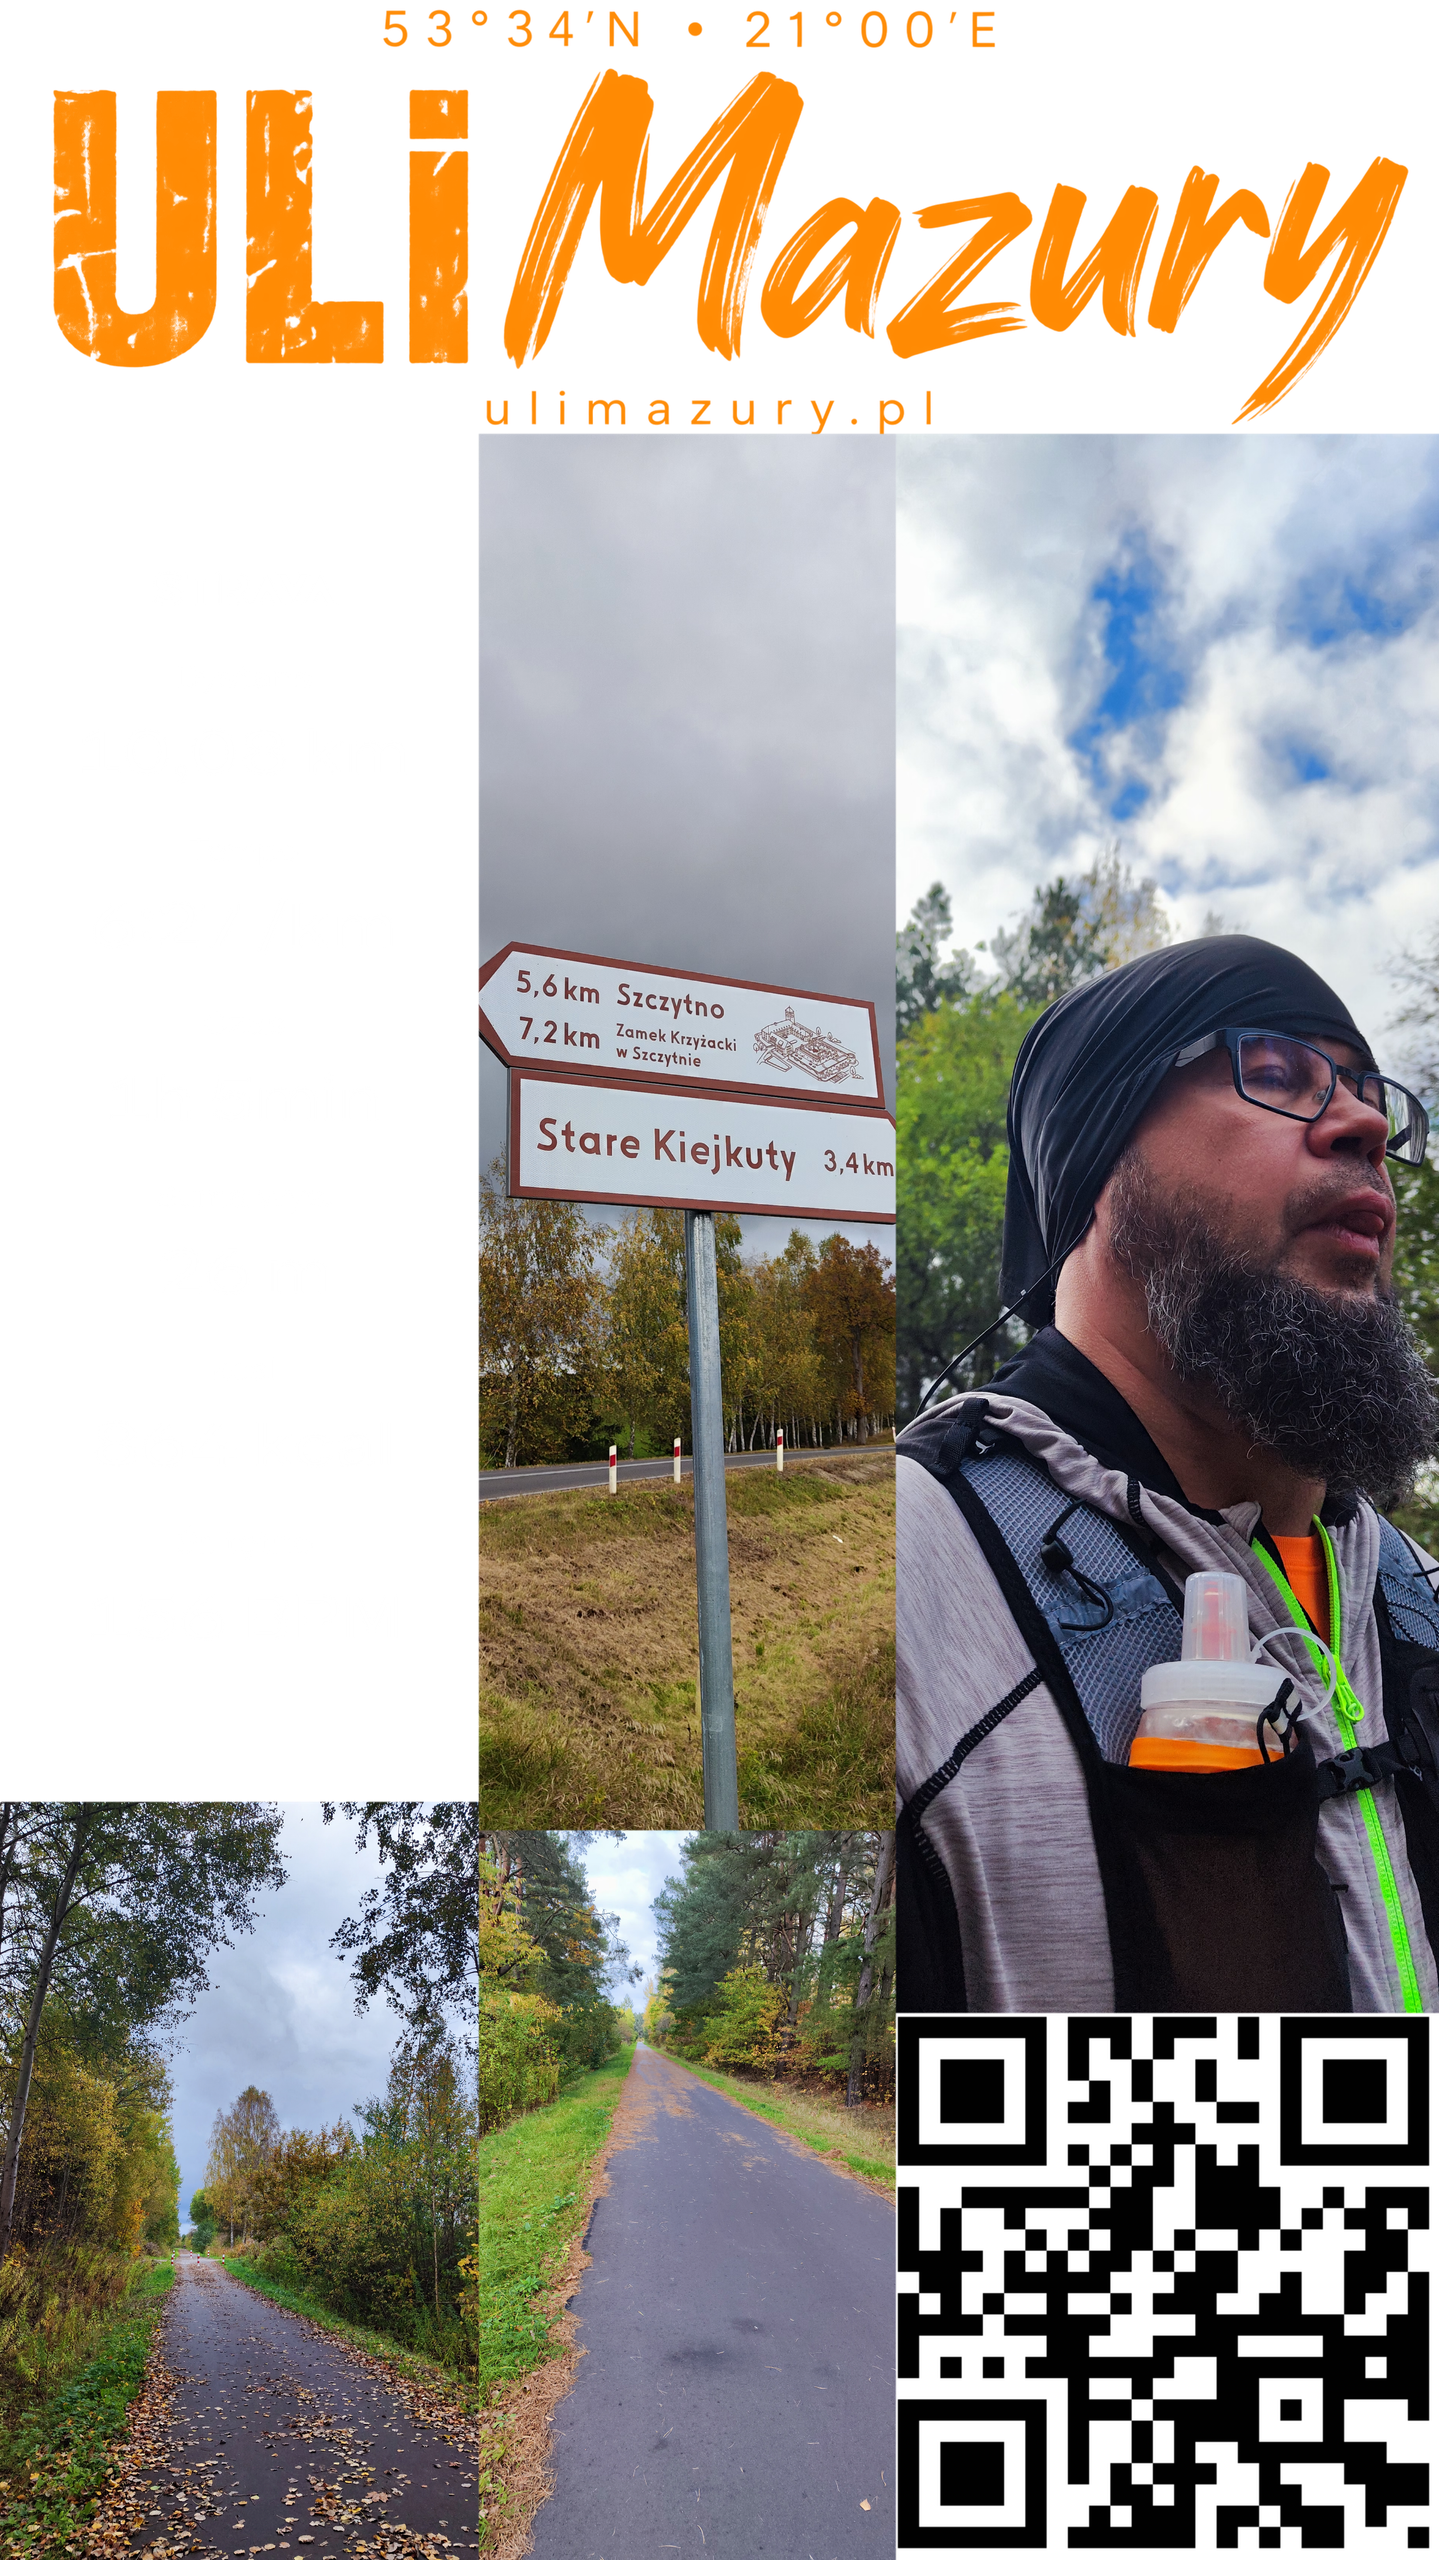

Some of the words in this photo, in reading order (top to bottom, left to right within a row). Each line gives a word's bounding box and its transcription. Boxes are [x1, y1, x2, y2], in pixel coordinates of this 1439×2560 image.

[516, 969, 558, 999] 5,6
[564, 977, 600, 1004] km
[617, 983, 725, 1019] Szczytno
[519, 1016, 557, 1045] 7,2
[564, 1023, 600, 1049] km
[616, 1023, 667, 1043] Zamek
[670, 1031, 738, 1052] Krzyżacki
[616, 1048, 628, 1059] w
[632, 1046, 702, 1068] Szczytnie
[537, 1117, 640, 1158] Stare
[654, 1128, 796, 1181] Kiejkuty
[824, 1150, 859, 1175] 3,4
